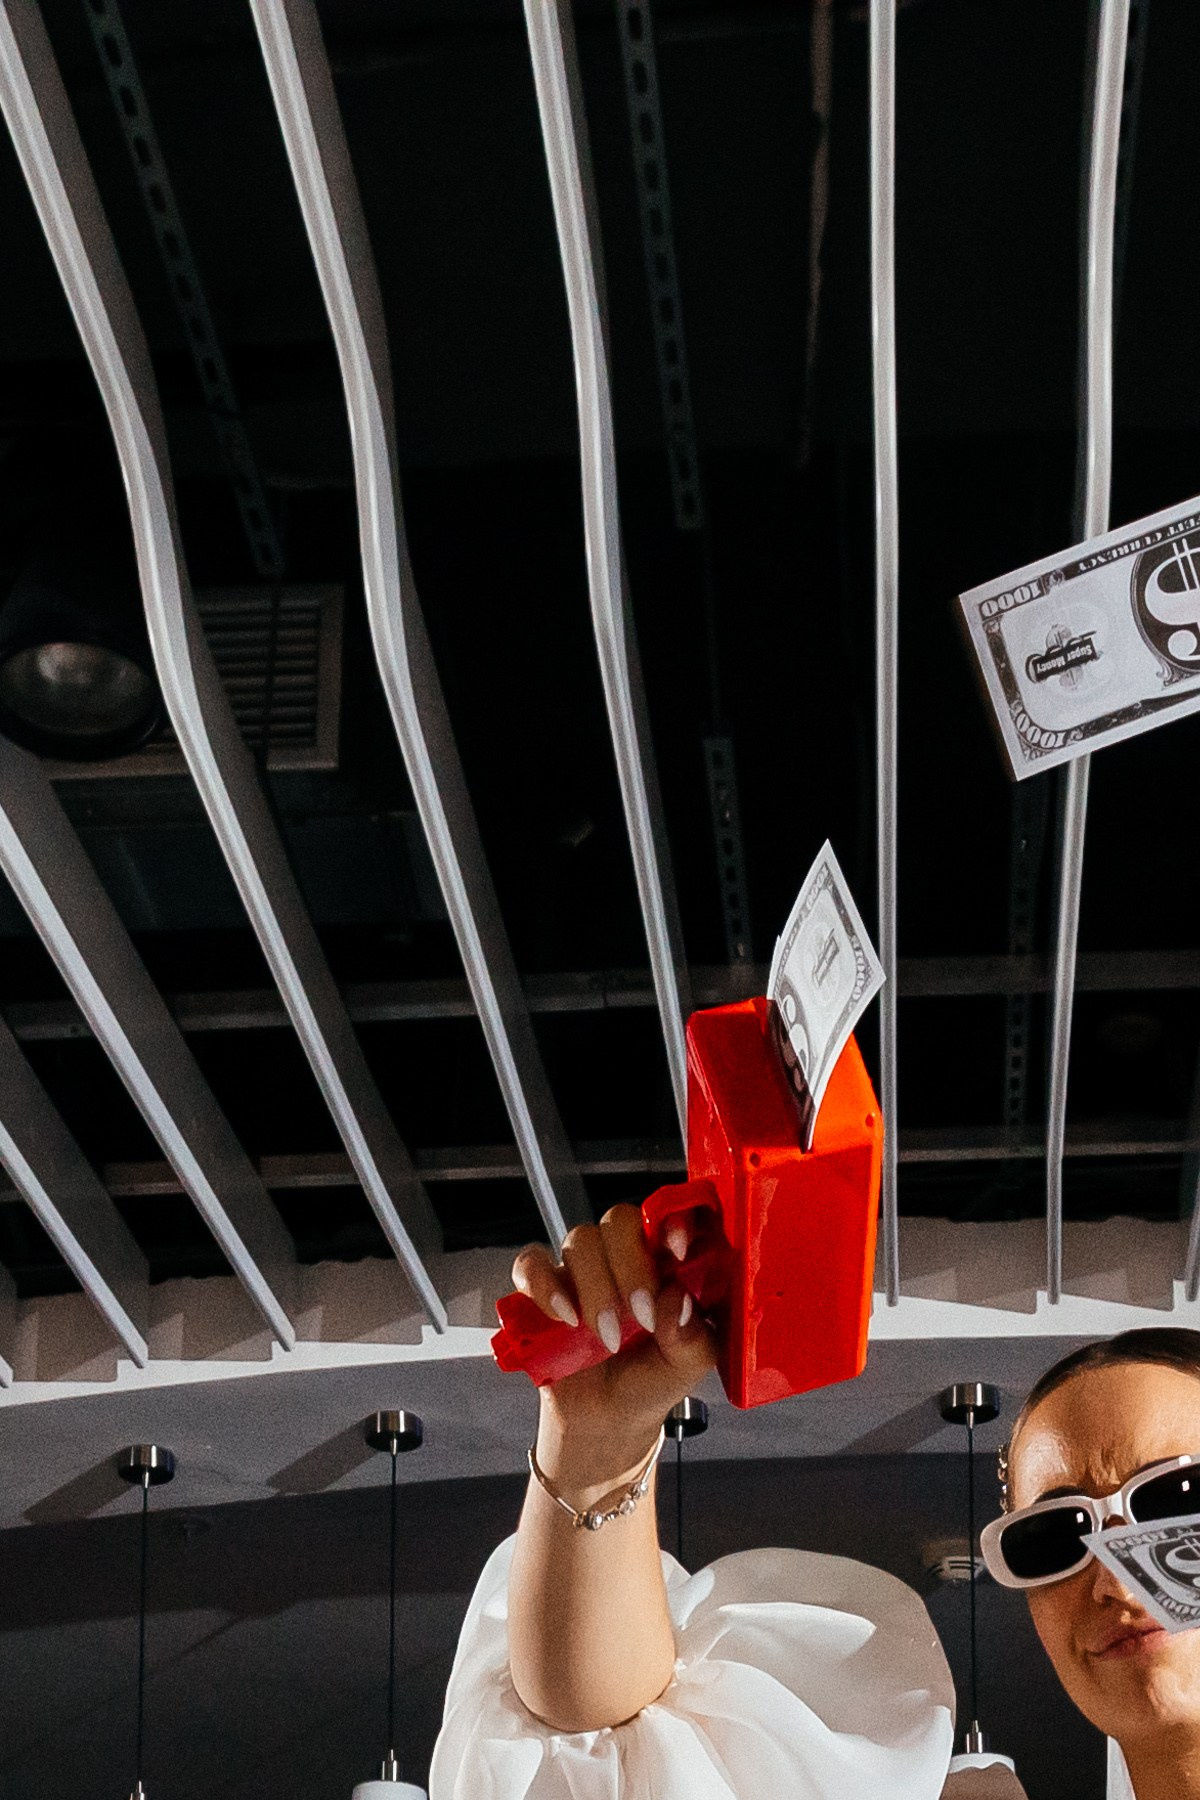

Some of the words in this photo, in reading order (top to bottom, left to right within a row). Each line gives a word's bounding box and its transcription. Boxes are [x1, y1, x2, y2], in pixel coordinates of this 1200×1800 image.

[1077, 531, 1163, 573] CURRENCY
[979, 583, 1042, 618] 1000
[1035, 655, 1066, 675] Money
[1067, 644, 1093, 662] Super
